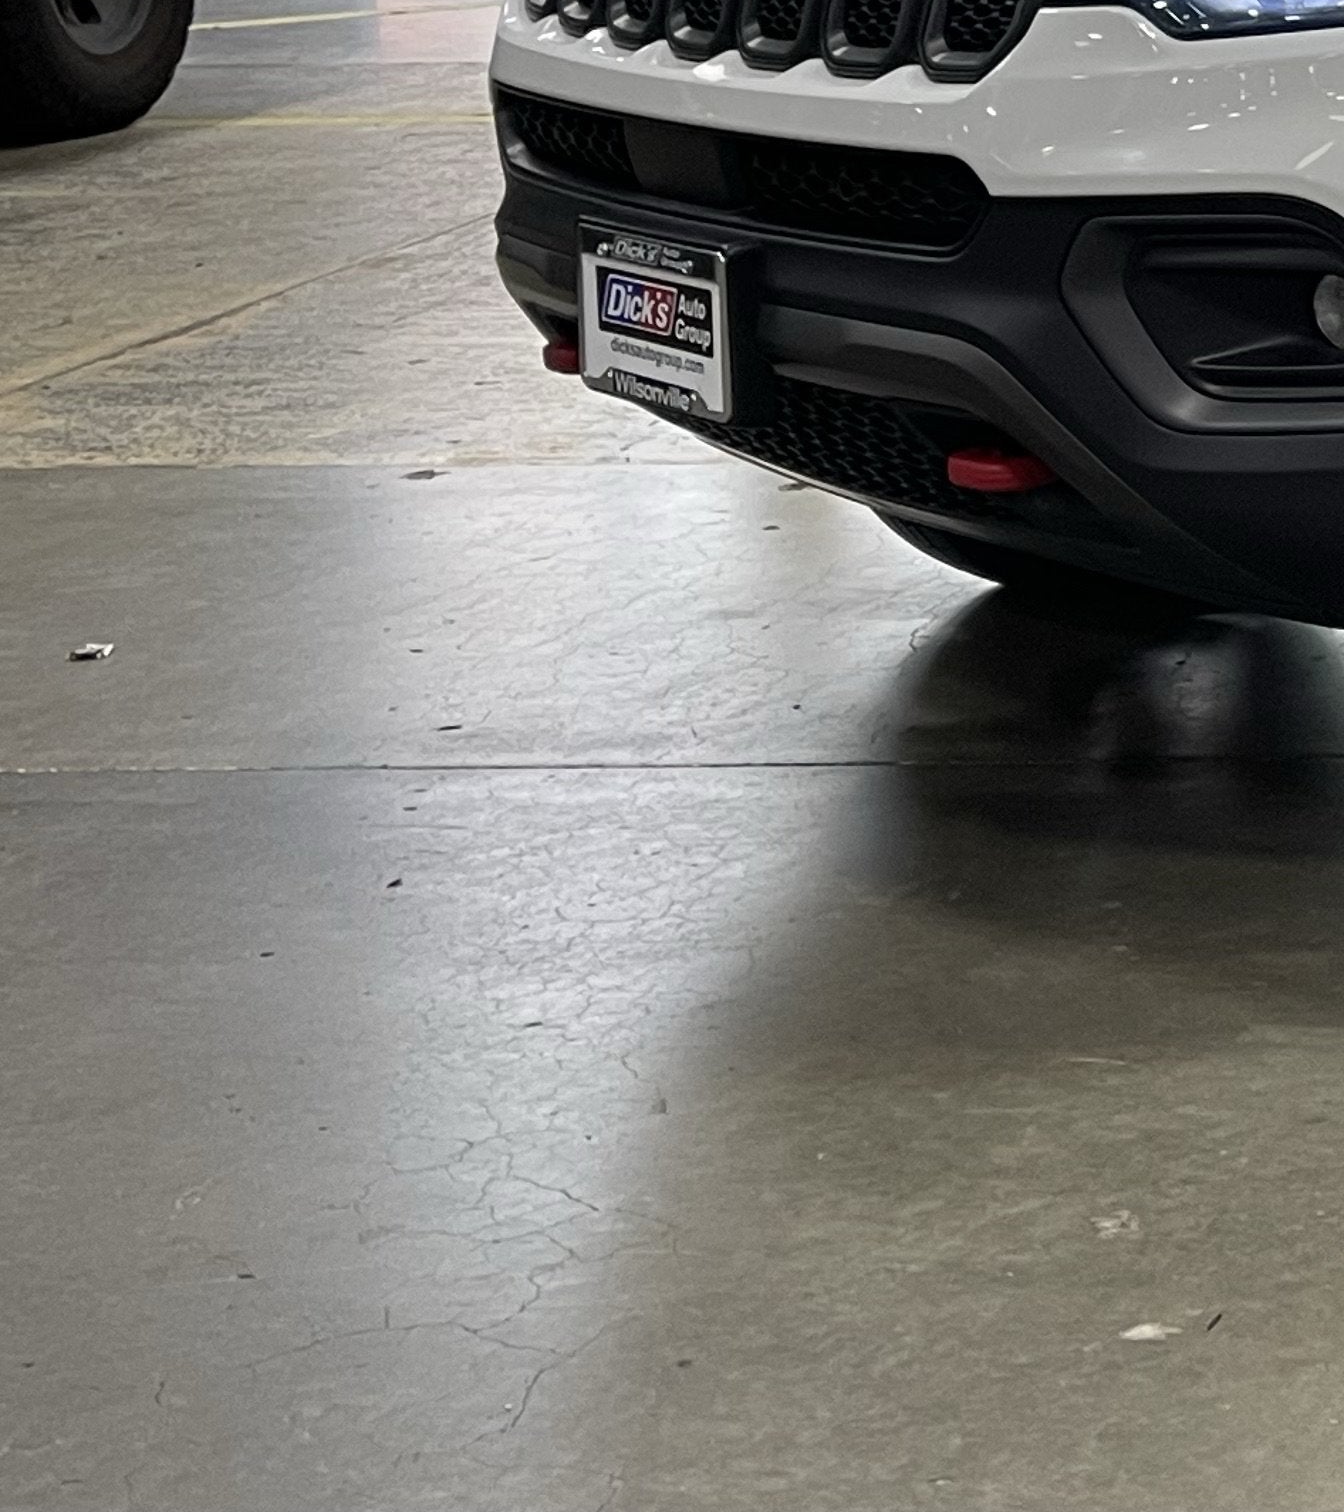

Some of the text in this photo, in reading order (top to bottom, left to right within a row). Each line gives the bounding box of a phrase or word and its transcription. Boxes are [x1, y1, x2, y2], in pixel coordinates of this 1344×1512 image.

[606, 283, 670, 329] Dick's
[677, 292, 707, 320] Auto
[675, 317, 711, 351] Group
[614, 369, 691, 412] Wilsonville
